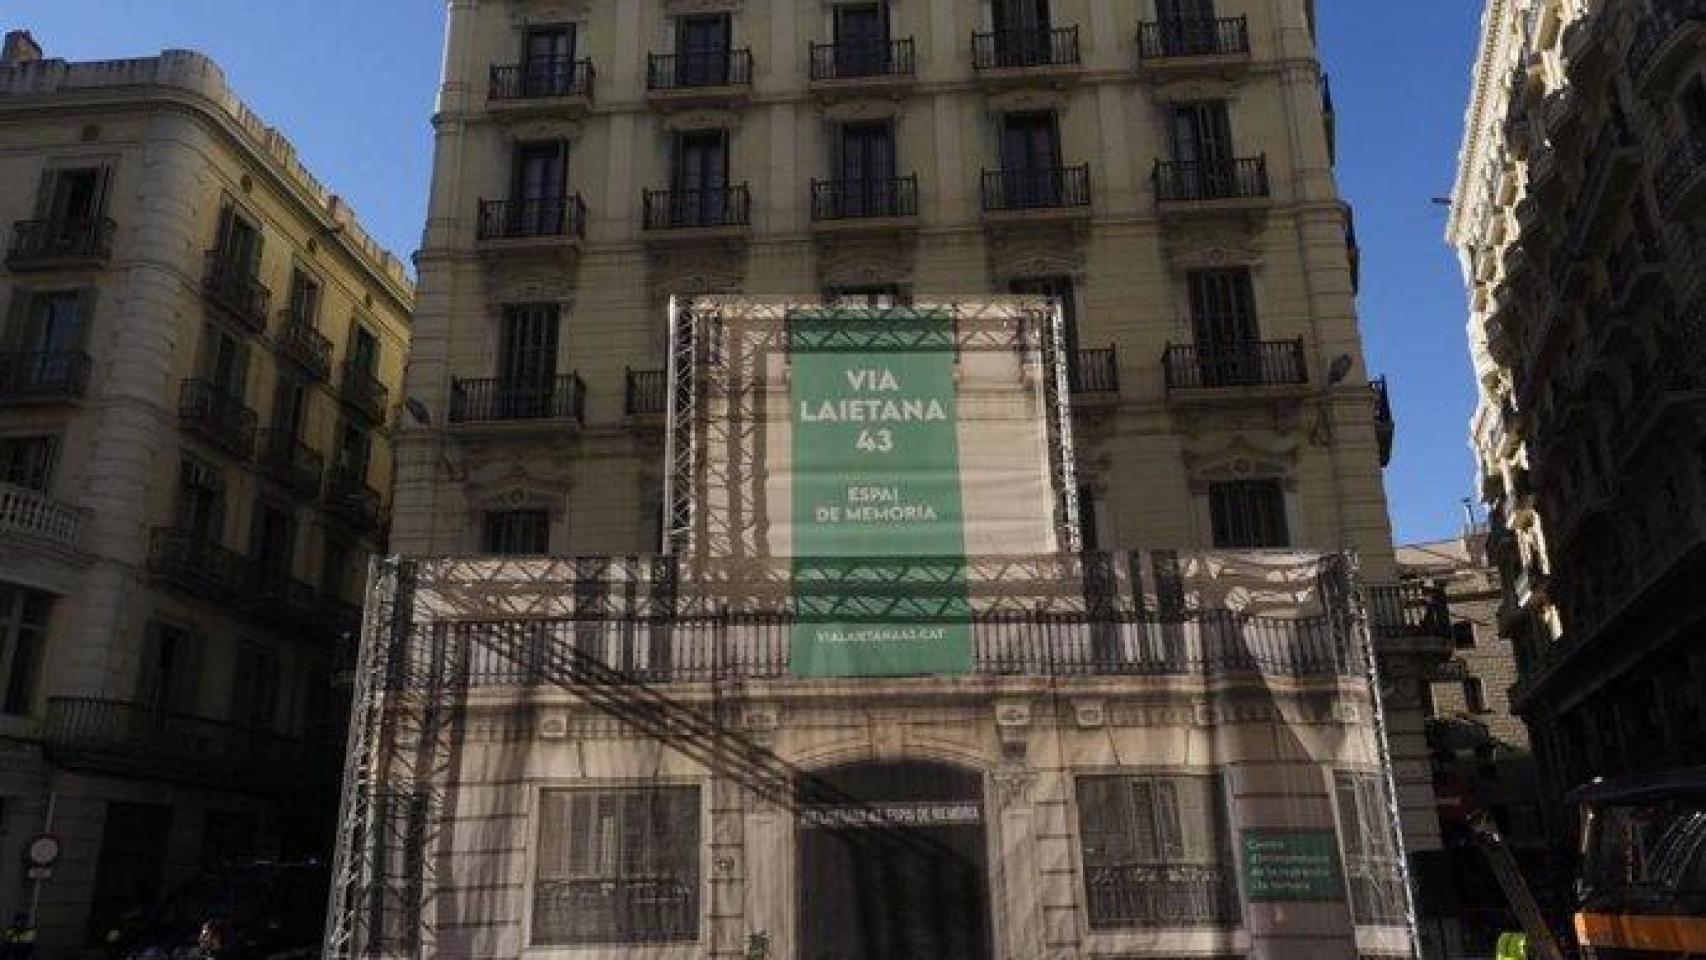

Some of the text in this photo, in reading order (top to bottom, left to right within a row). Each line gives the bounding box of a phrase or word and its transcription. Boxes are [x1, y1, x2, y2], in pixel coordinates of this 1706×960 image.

[846, 368, 899, 391] VIA
[800, 399, 946, 421] LAIETANA
[855, 430, 893, 451] 43
[847, 486, 898, 502] ESPAI
[815, 506, 841, 522] DE
